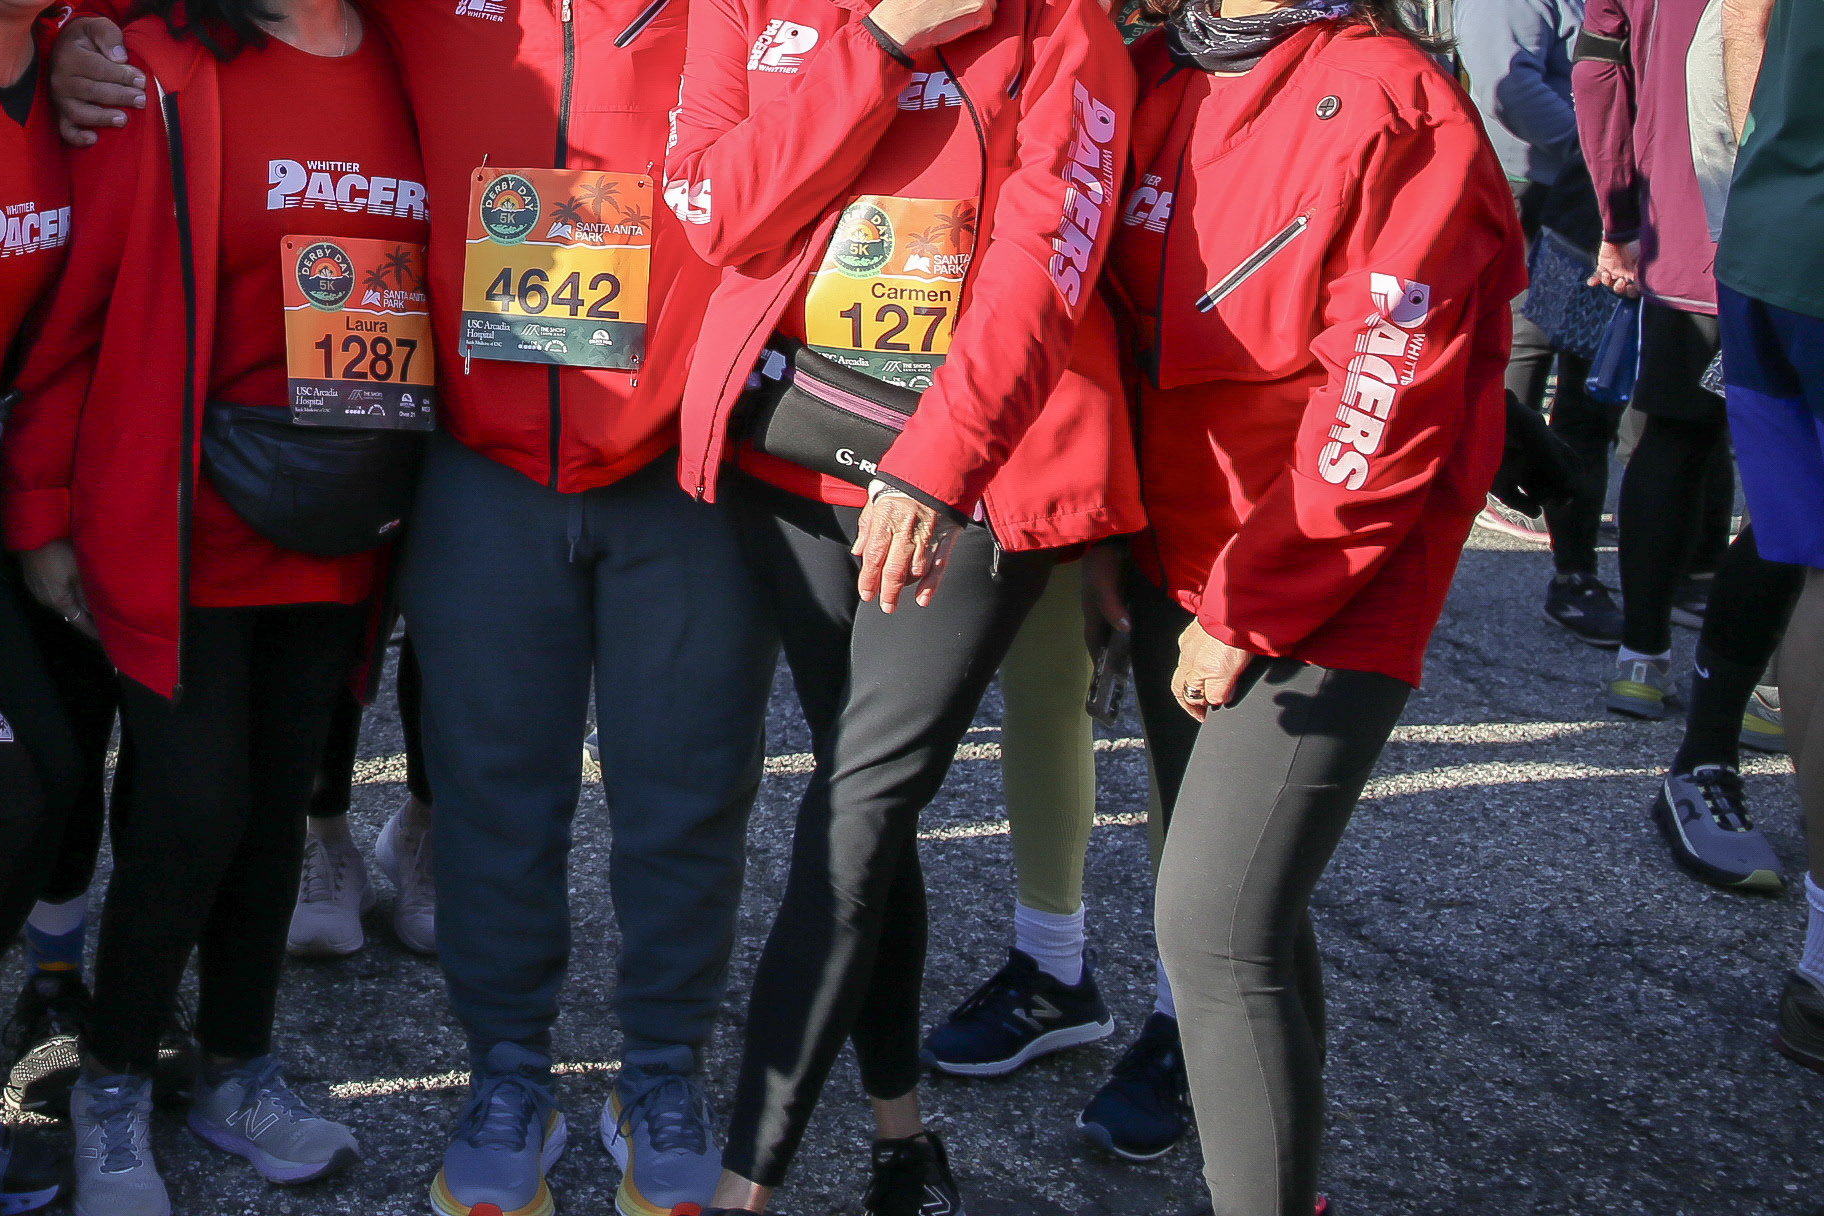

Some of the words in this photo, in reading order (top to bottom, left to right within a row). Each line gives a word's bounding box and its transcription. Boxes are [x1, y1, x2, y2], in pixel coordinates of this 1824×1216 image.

[467, 10, 504, 22] WHITTIER
[758, 64, 799, 74] WHITTIER
[307, 160, 360, 172] WHITTIER
[1102, 148, 1113, 208] WHITTIER
[267, 159, 430, 222] PACER
[485, 180, 516, 209] DERBY
[517, 186, 535, 212] DAY
[1049, 79, 1116, 306] PACERS
[499, 213, 516, 225] 5K
[575, 222, 611, 234] SANTA
[611, 225, 645, 237] ANITA
[871, 214, 892, 242] DAY
[575, 231, 605, 243] PARK
[849, 243, 869, 256] 5K
[301, 248, 332, 275] DERBY
[334, 255, 352, 278] DAY
[934, 254, 971, 265] SANTA
[933, 264, 964, 275] PARK
[319, 280, 335, 291] 5K
[871, 282, 952, 302] Carmen
[383, 289, 409, 300] SANTA
[409, 292, 426, 302] ANIT
[485, 267, 621, 319] 4642
[383, 298, 404, 308] PARK
[346, 316, 388, 333] Laura
[840, 302, 947, 352] 127
[315, 334, 418, 382] 1287
[838, 356, 869, 367] Arcadia
[1317, 272, 1431, 491] PACERS
[296, 386, 312, 396] USC
[313, 387, 338, 397] Arcadia
[296, 395, 324, 407] Hospital
